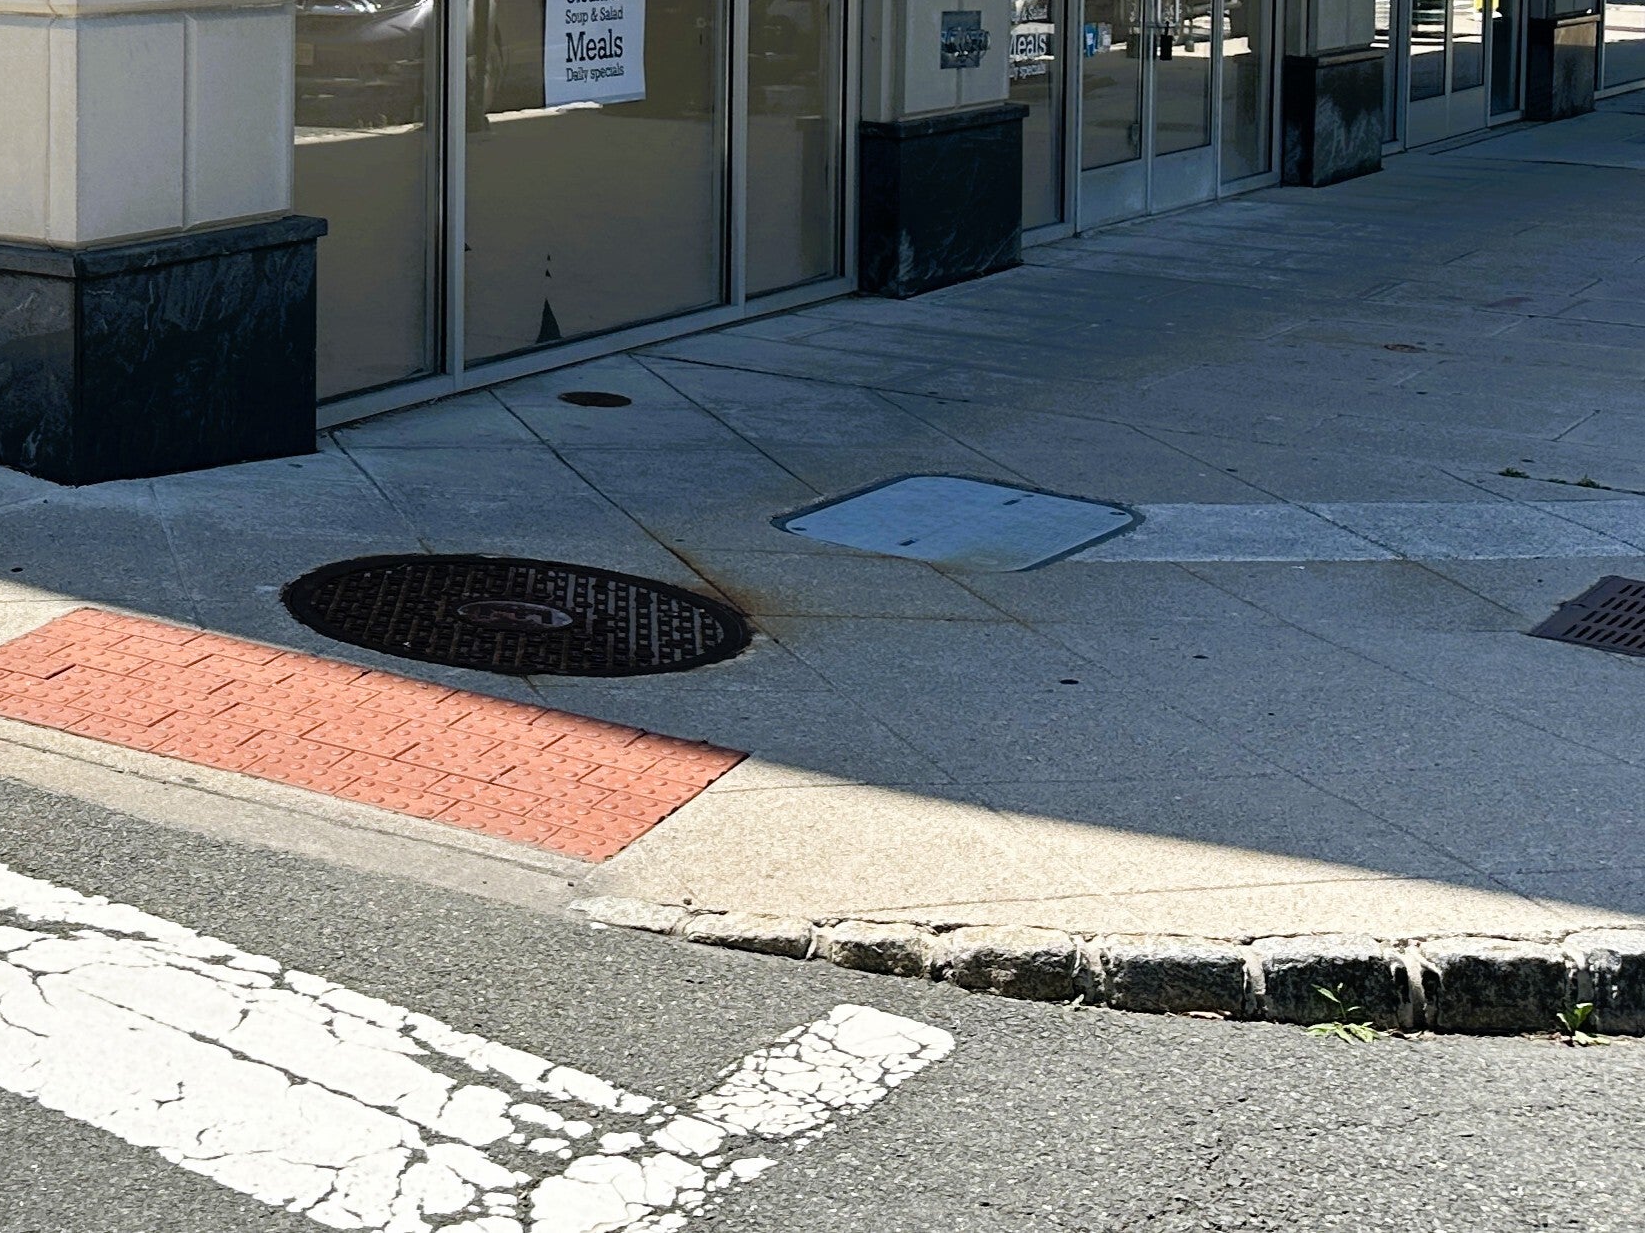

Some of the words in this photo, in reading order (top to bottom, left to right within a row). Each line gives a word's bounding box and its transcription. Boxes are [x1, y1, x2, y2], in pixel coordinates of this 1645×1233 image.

[565, 8, 588, 26] Soup
[590, 7, 598, 23] &
[599, 6, 624, 23] Salad
[565, 28, 624, 63] Meals
[566, 66, 589, 83] Daily
[590, 63, 625, 83] specials
